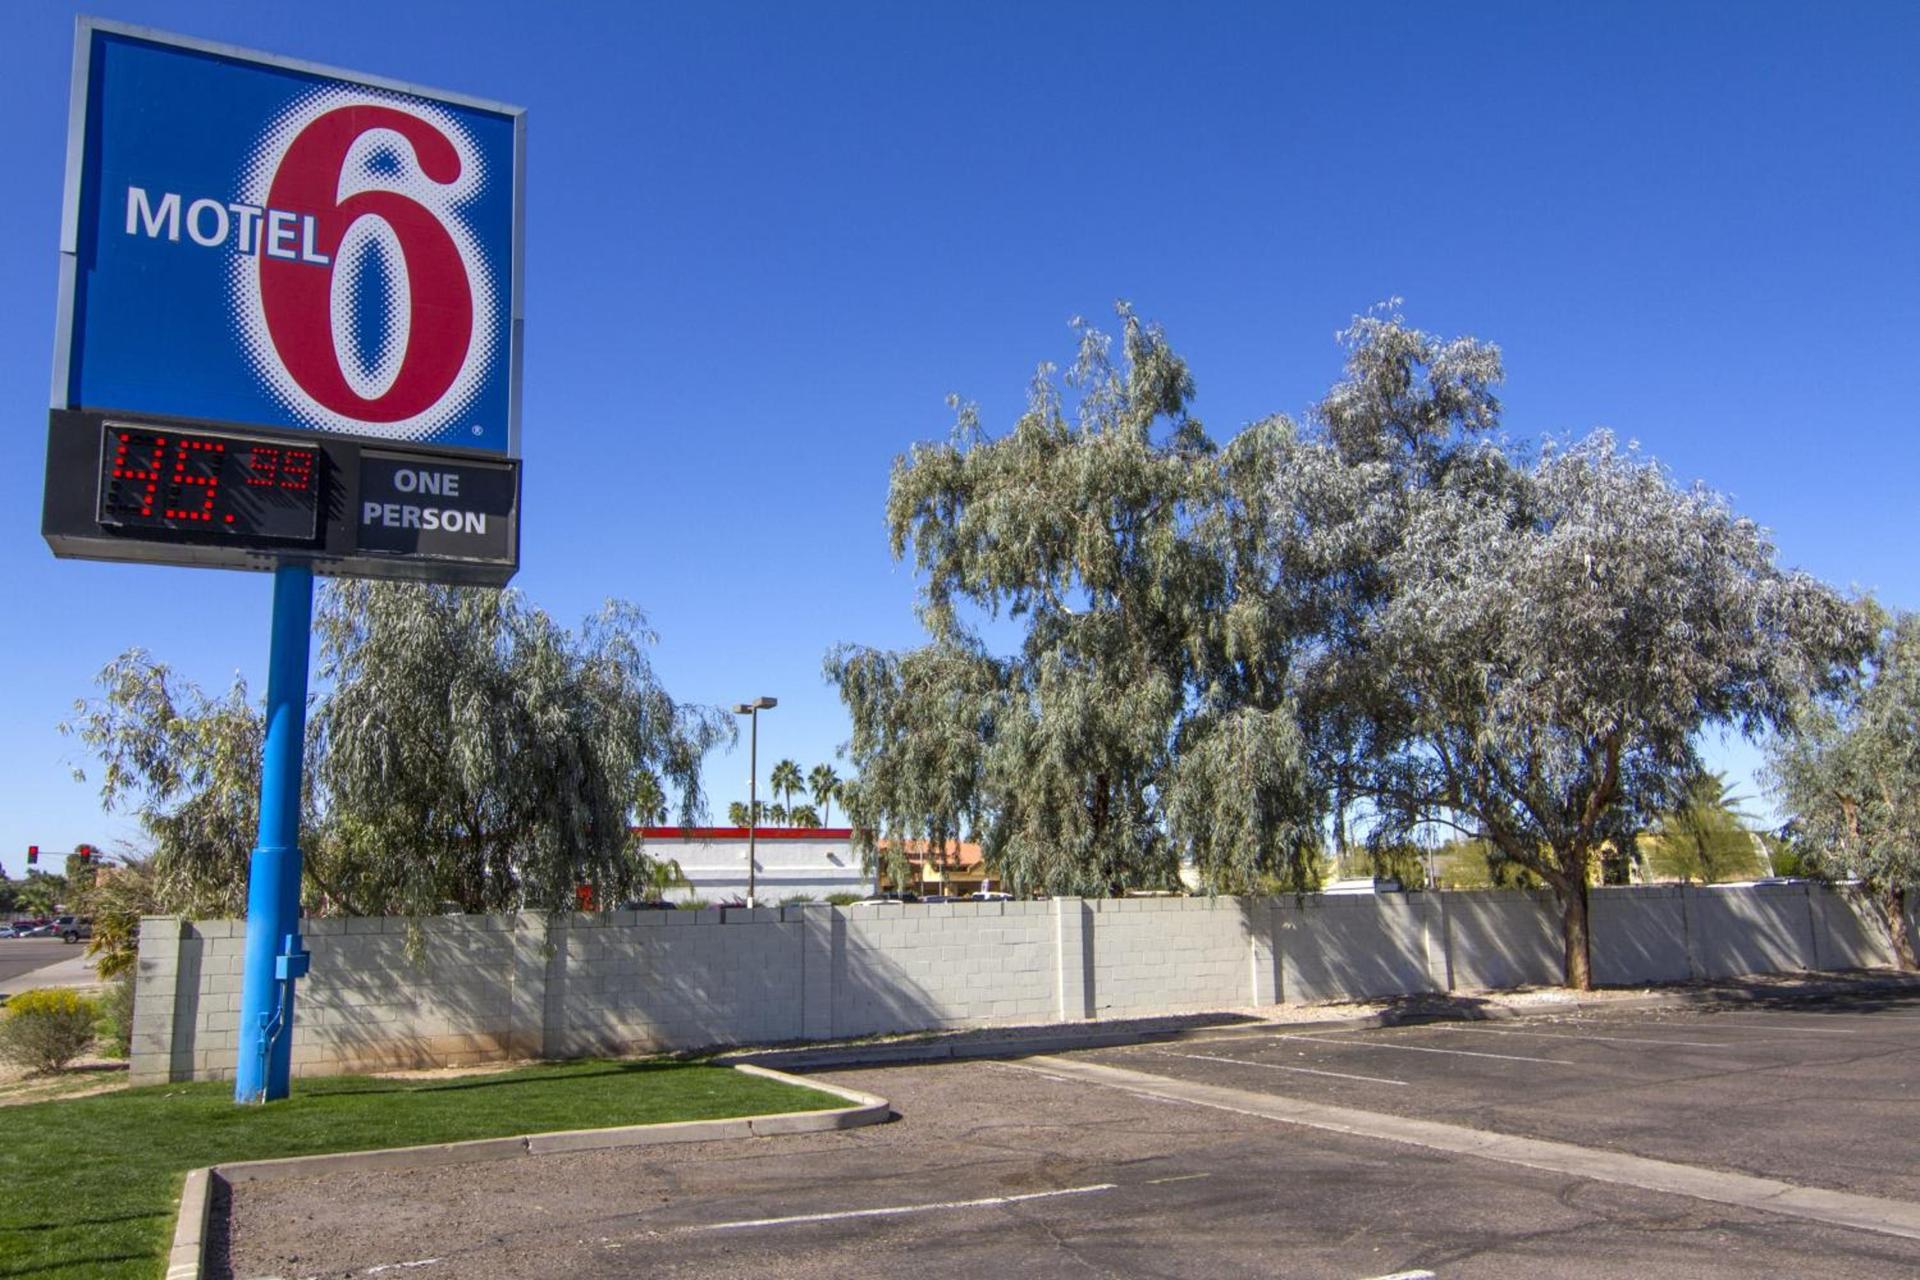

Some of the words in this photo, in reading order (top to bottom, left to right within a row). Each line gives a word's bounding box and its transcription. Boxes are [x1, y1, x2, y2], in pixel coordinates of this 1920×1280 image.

[126, 186, 330, 265] MOTEL
[259, 103, 474, 424] 6
[393, 468, 460, 497] ONE
[362, 501, 487, 535] PERSON
